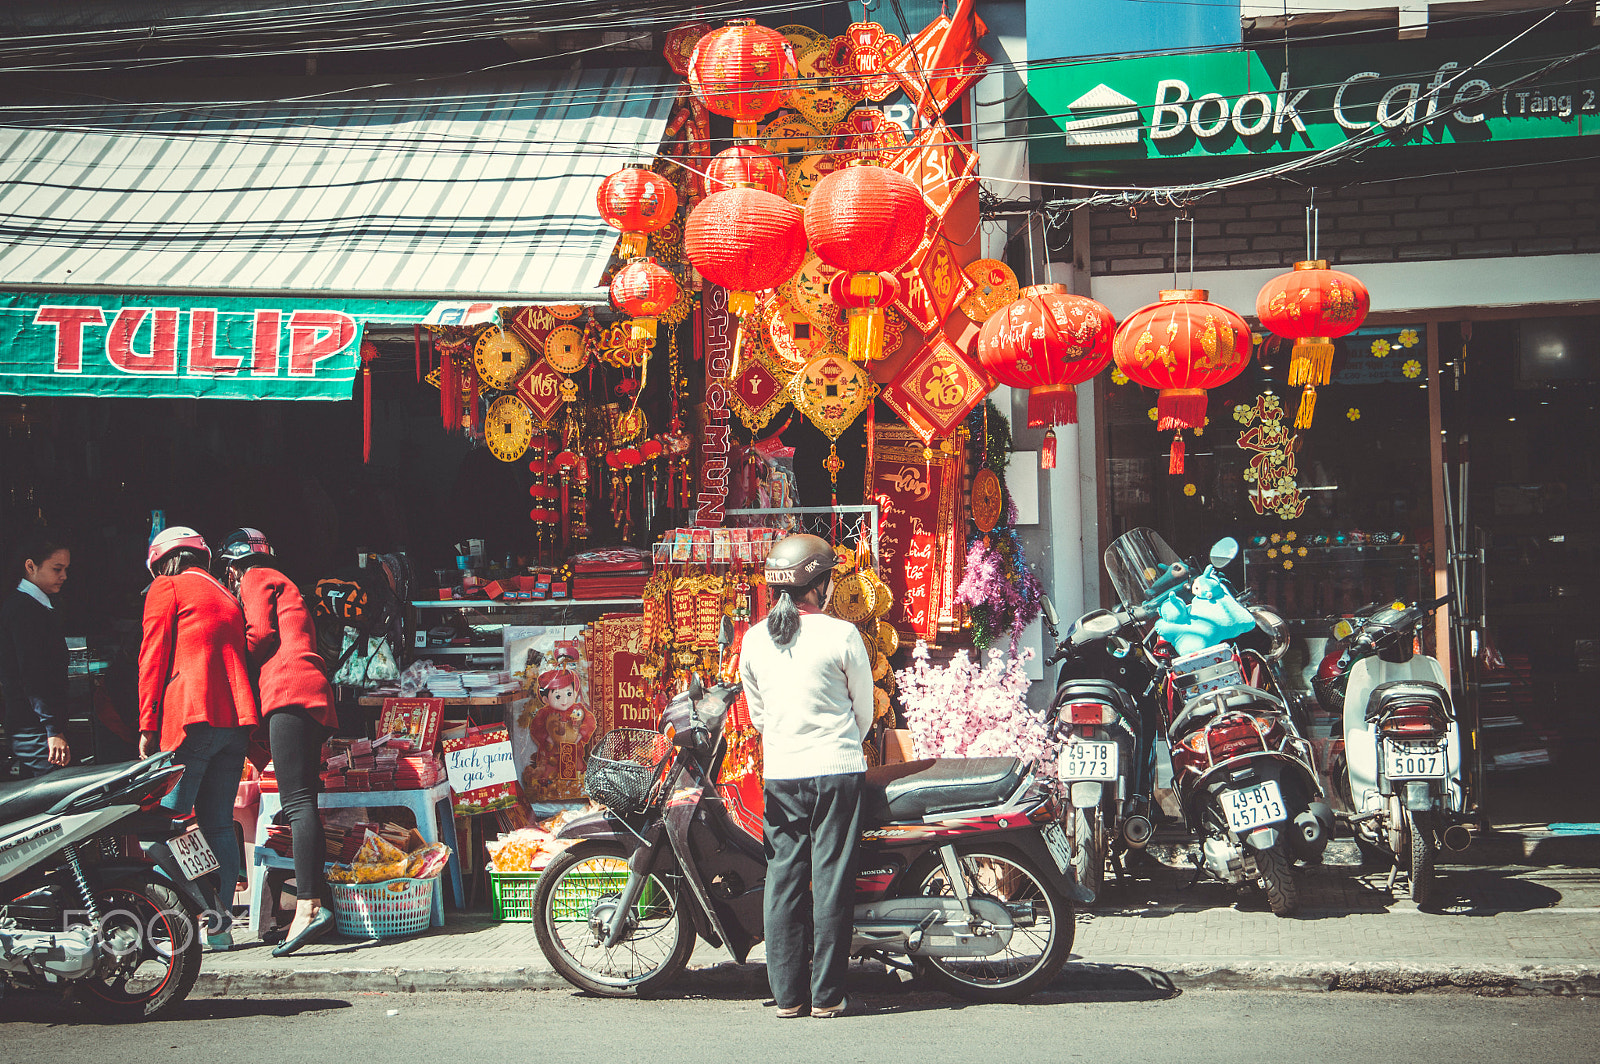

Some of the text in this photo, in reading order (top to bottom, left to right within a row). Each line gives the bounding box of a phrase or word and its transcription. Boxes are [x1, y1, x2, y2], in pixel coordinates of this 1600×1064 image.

[1150, 61, 1492, 140] Book Cafe
[31, 304, 358, 377] TULIP
[924, 363, 964, 407] 福
[618, 681, 646, 699] Kha
[1068, 744, 1108, 761] 49-T8
[1068, 761, 1108, 776] 9773
[1395, 757, 1437, 774] 5007
[1232, 786, 1271, 810] 49-B1
[1232, 801, 1281, 828] 457.13
[175, 832, 204, 857] 49-B1
[182, 849, 217, 876] 139.36
